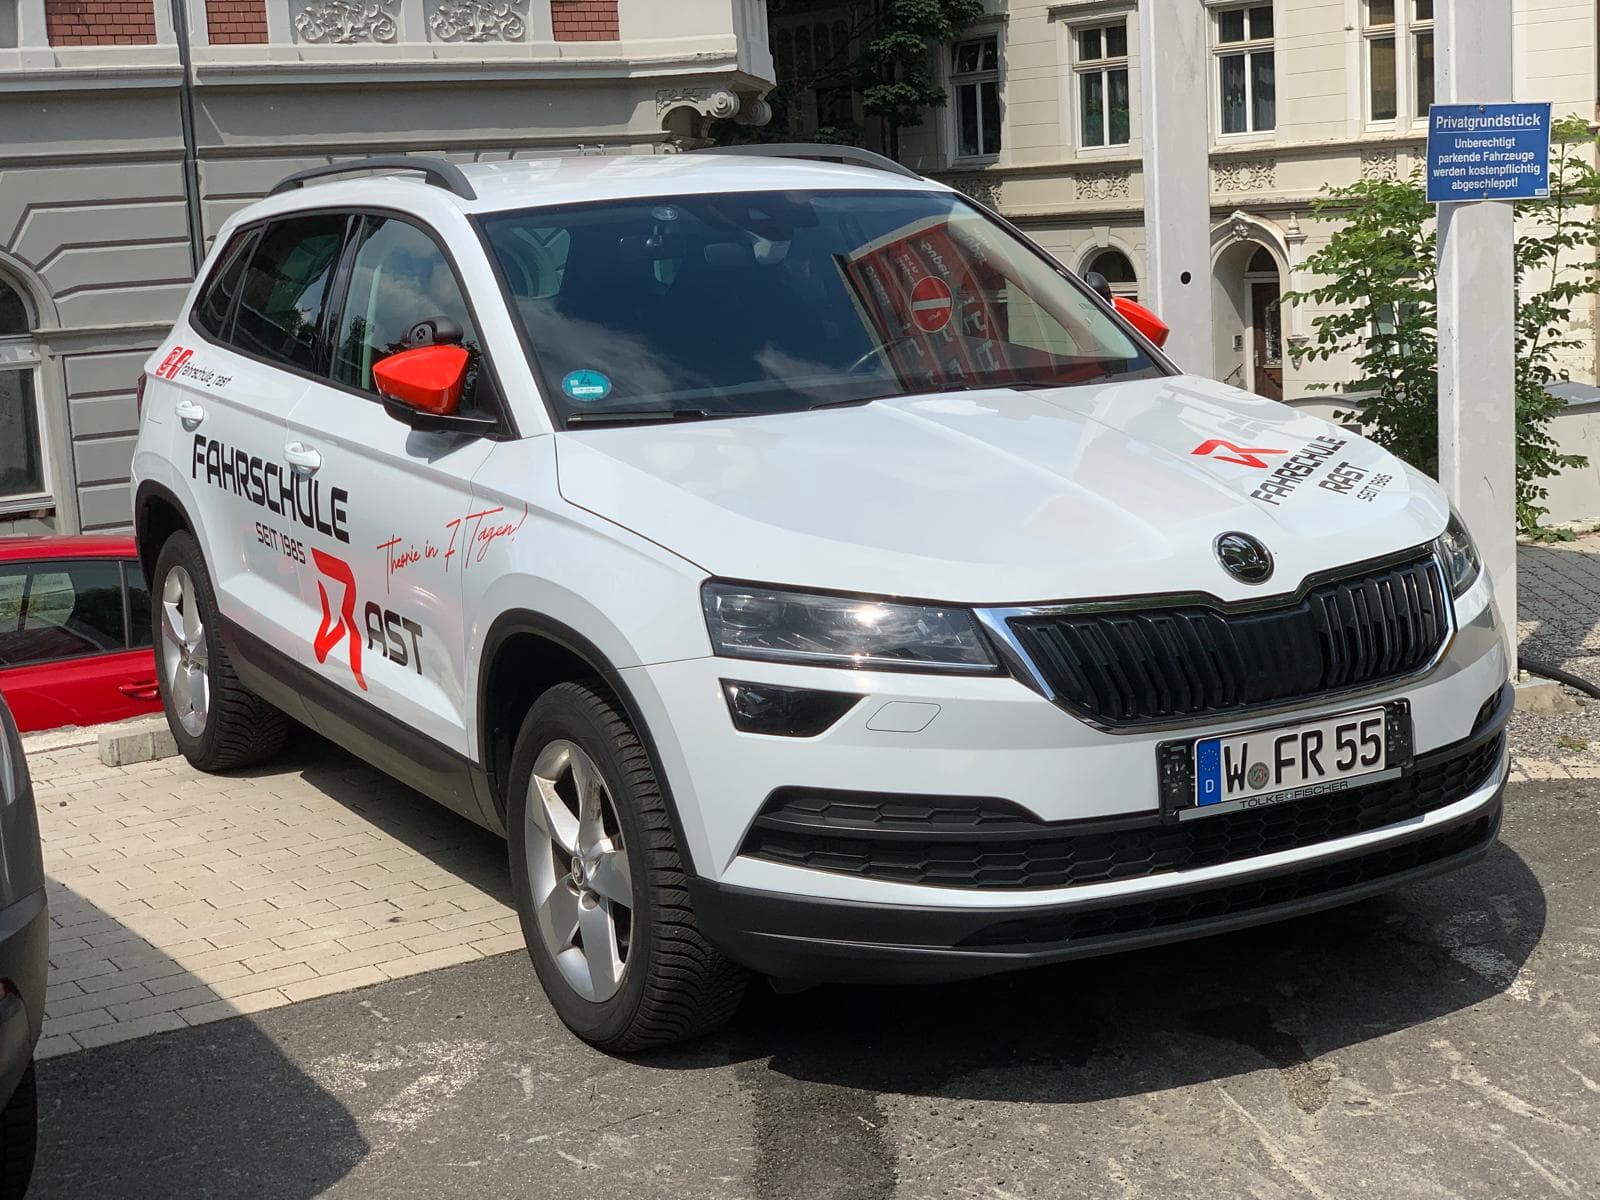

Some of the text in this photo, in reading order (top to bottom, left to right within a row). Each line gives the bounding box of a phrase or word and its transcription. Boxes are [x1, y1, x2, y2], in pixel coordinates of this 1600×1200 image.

[1436, 113, 1541, 131] Privatgrundstück
[1455, 137, 1516, 149] Unberechtigt
[1433, 164, 1541, 177] werden kostenpflichtig
[1438, 151, 1535, 165] parkende Fahrzeuge
[1451, 177, 1518, 191] abgeschleppt!
[1250, 435, 1348, 506] FAHRSCHULE
[1318, 461, 1370, 495] RAST
[192, 434, 350, 544] FAHRSCHULE
[255, 521, 306, 565] SEIT 1985
[376, 503, 528, 595] Theorie in 7 Tagen!
[1223, 742, 1248, 793] W
[1274, 729, 1325, 785] FR
[1335, 718, 1382, 771] 55
[1205, 779, 1214, 793] D
